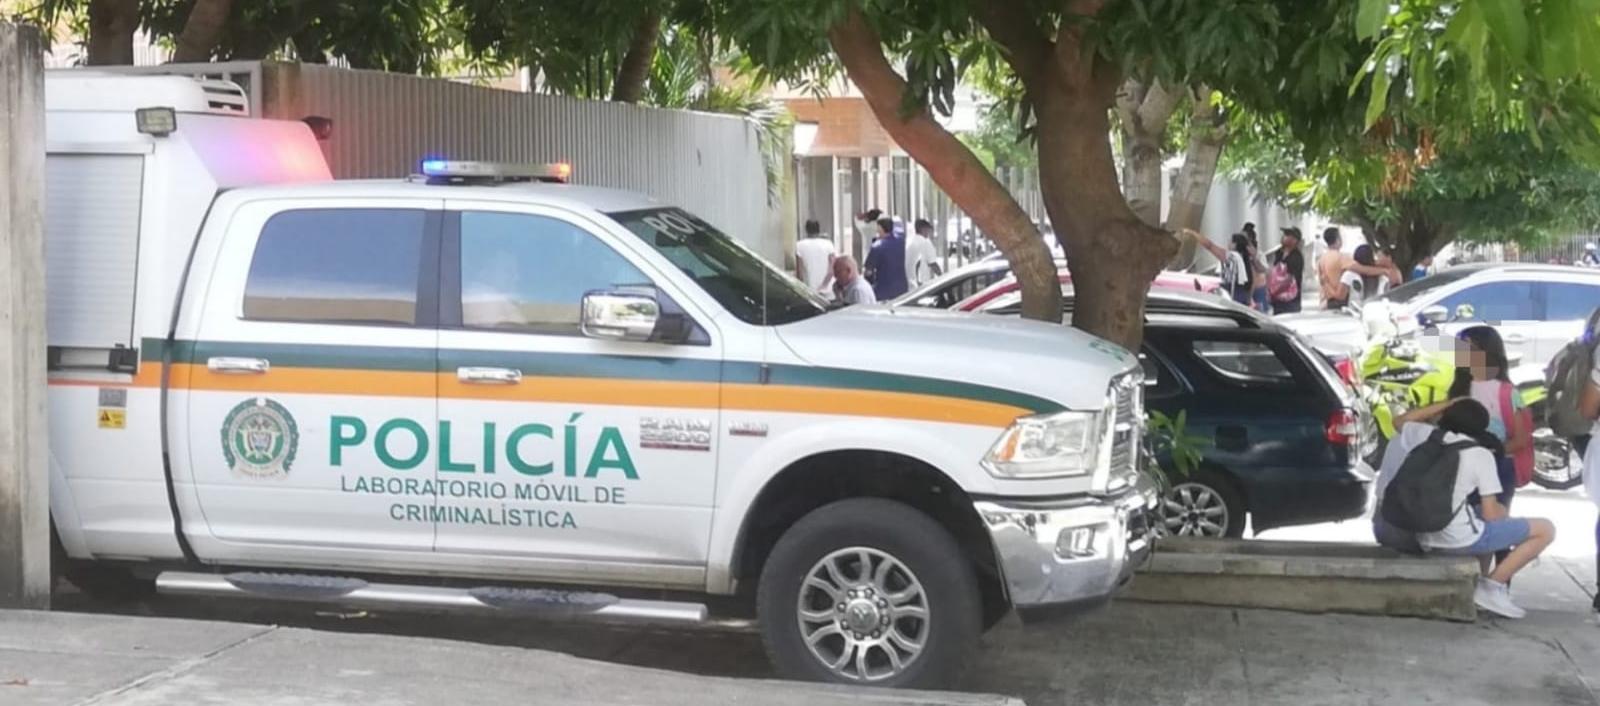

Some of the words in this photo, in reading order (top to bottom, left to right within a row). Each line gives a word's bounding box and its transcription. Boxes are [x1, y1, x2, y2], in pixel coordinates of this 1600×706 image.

[329, 412, 640, 480] POLICÍA
[340, 475, 507, 500] LABORATORIO
[514, 479, 587, 503] MÓVIL
[594, 486, 627, 505] DE
[389, 503, 578, 530] CRIMINALÍSTICA
